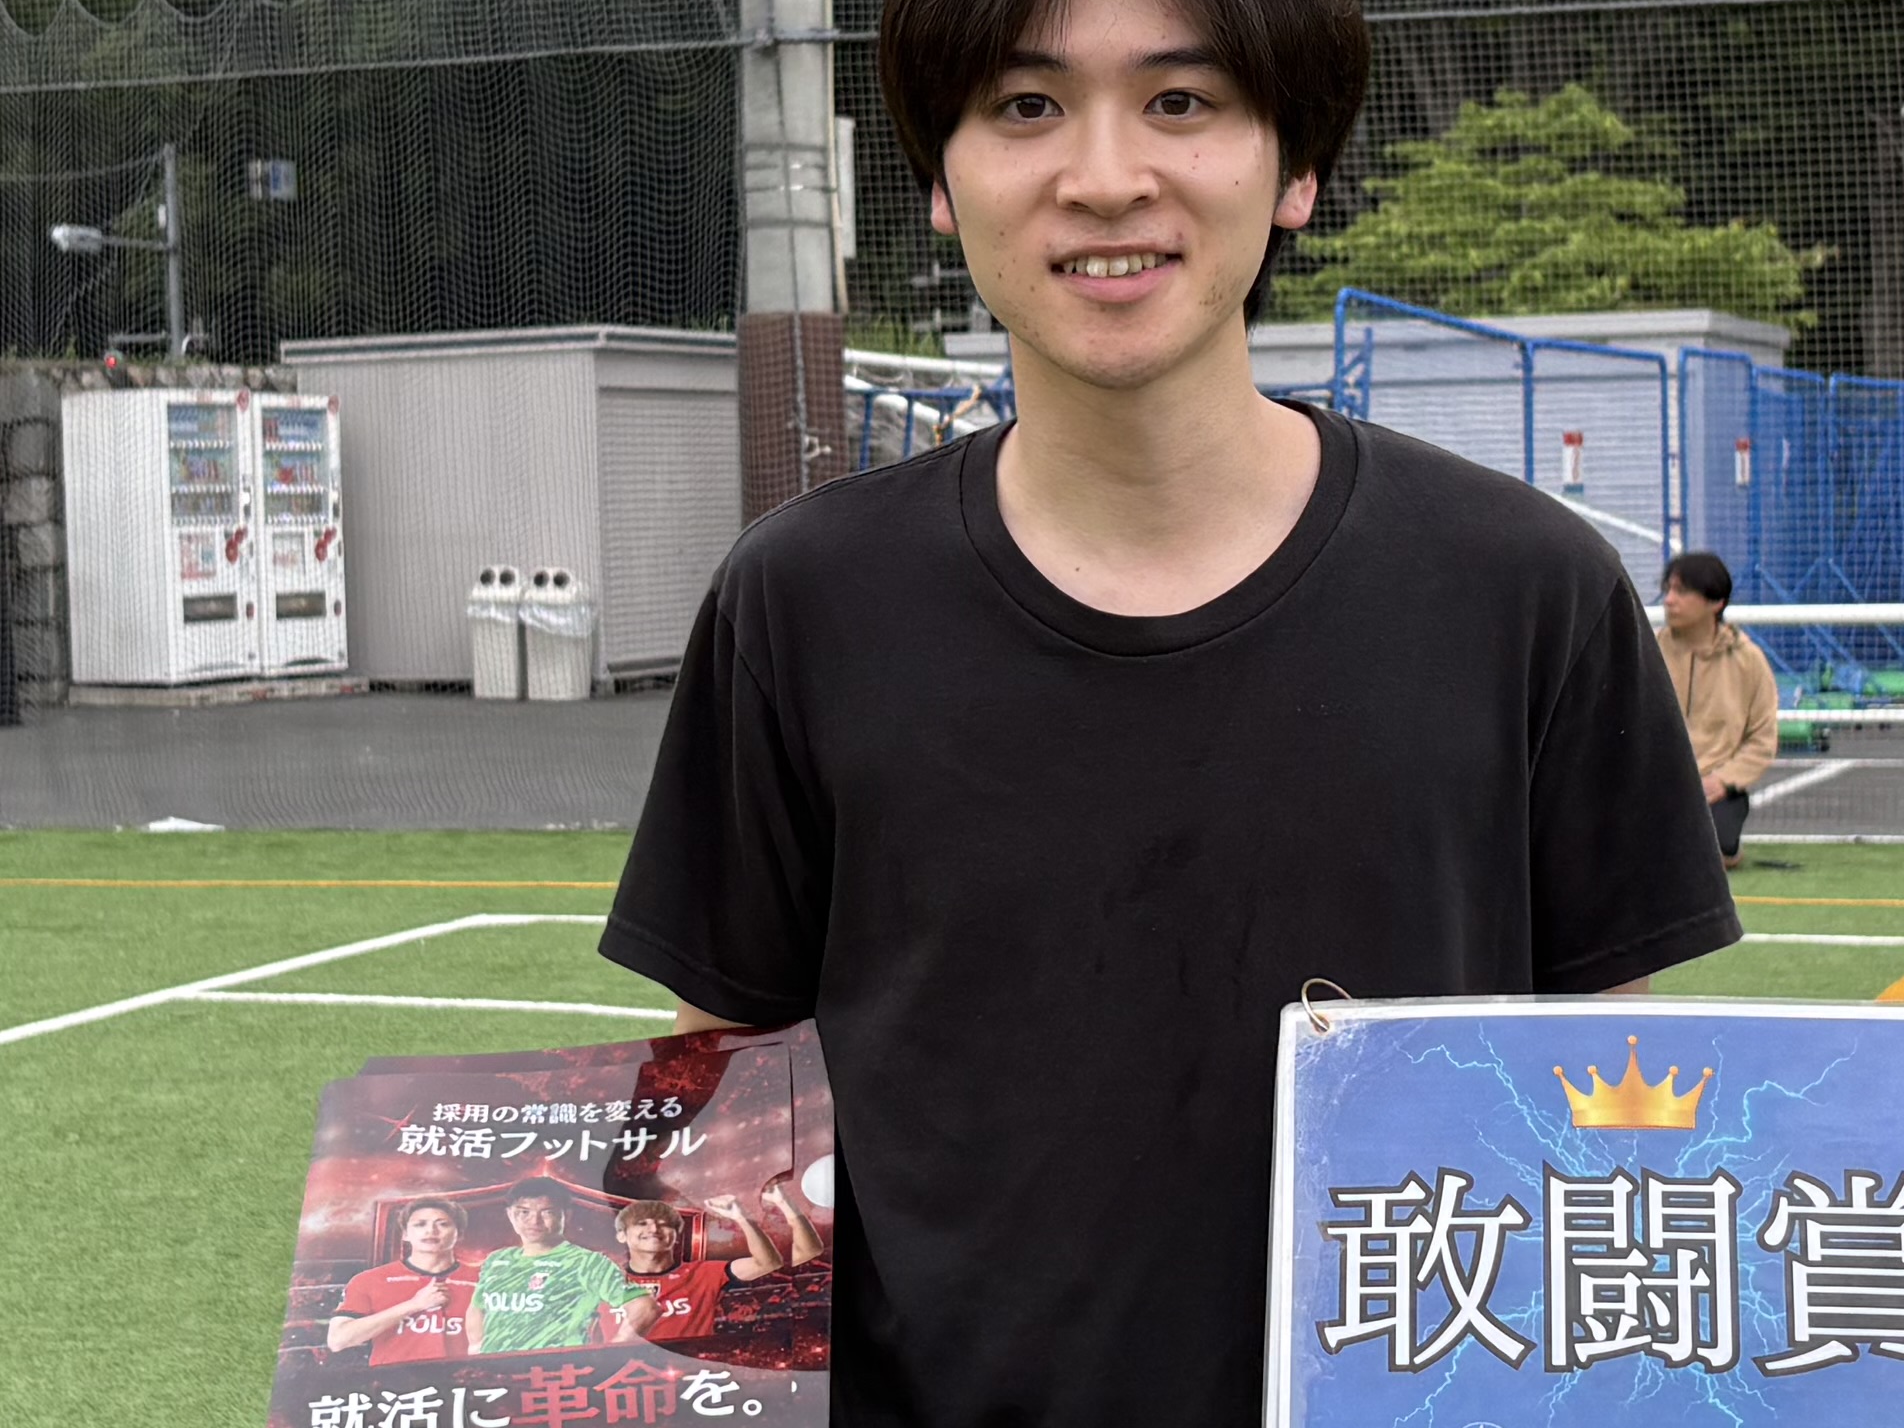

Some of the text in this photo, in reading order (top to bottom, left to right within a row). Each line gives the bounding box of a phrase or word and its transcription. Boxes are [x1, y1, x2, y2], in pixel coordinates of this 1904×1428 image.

[432, 1096, 683, 1125] 採用の常識を変える
[397, 1124, 708, 1162] 就活フットサル
